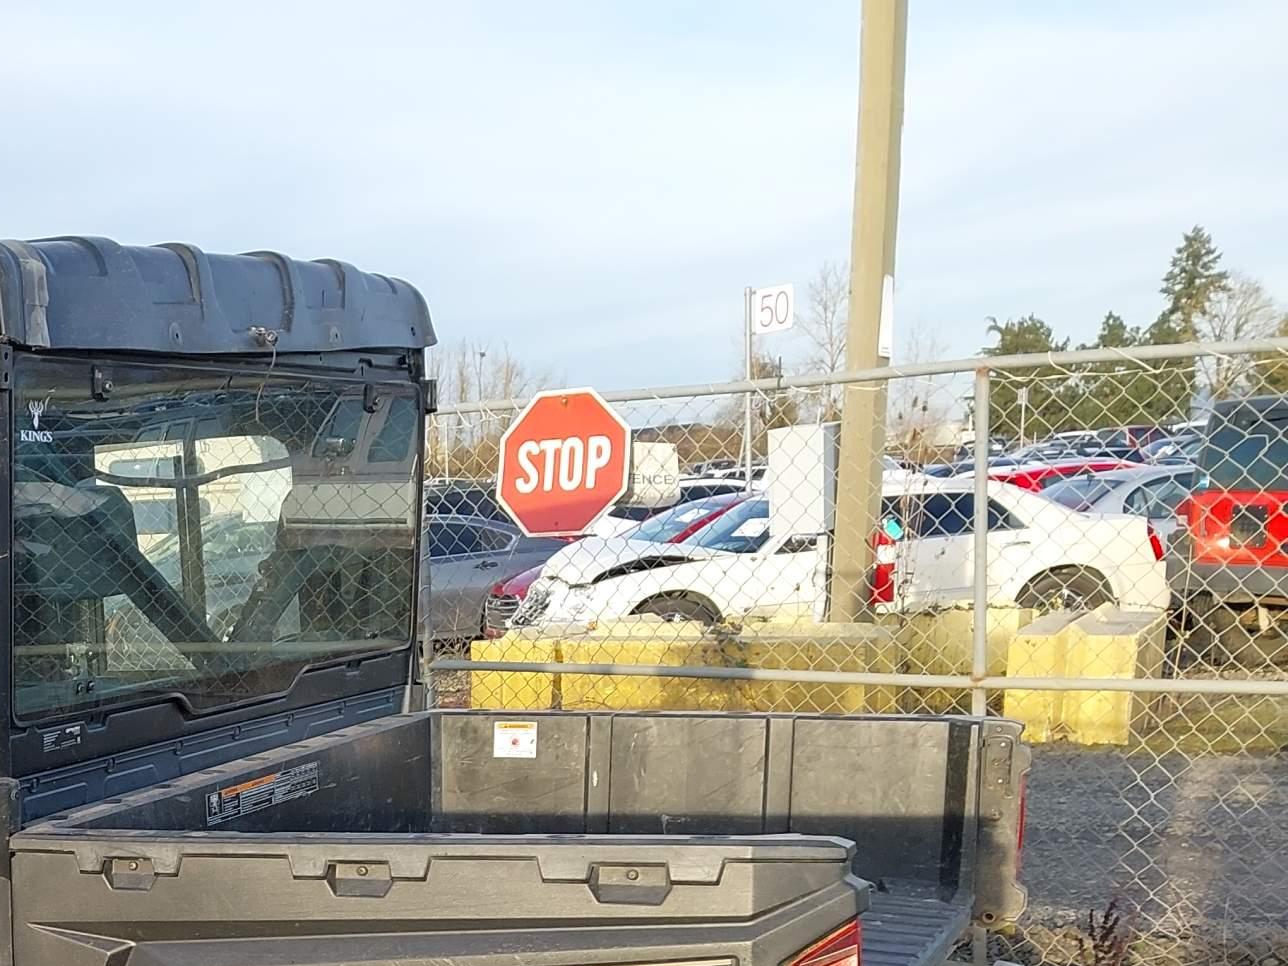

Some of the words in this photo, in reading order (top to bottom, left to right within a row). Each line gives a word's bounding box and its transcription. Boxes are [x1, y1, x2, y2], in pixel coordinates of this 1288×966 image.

[759, 290, 789, 327] 50
[515, 435, 611, 494] STOP
[632, 473, 673, 485] ENCE
